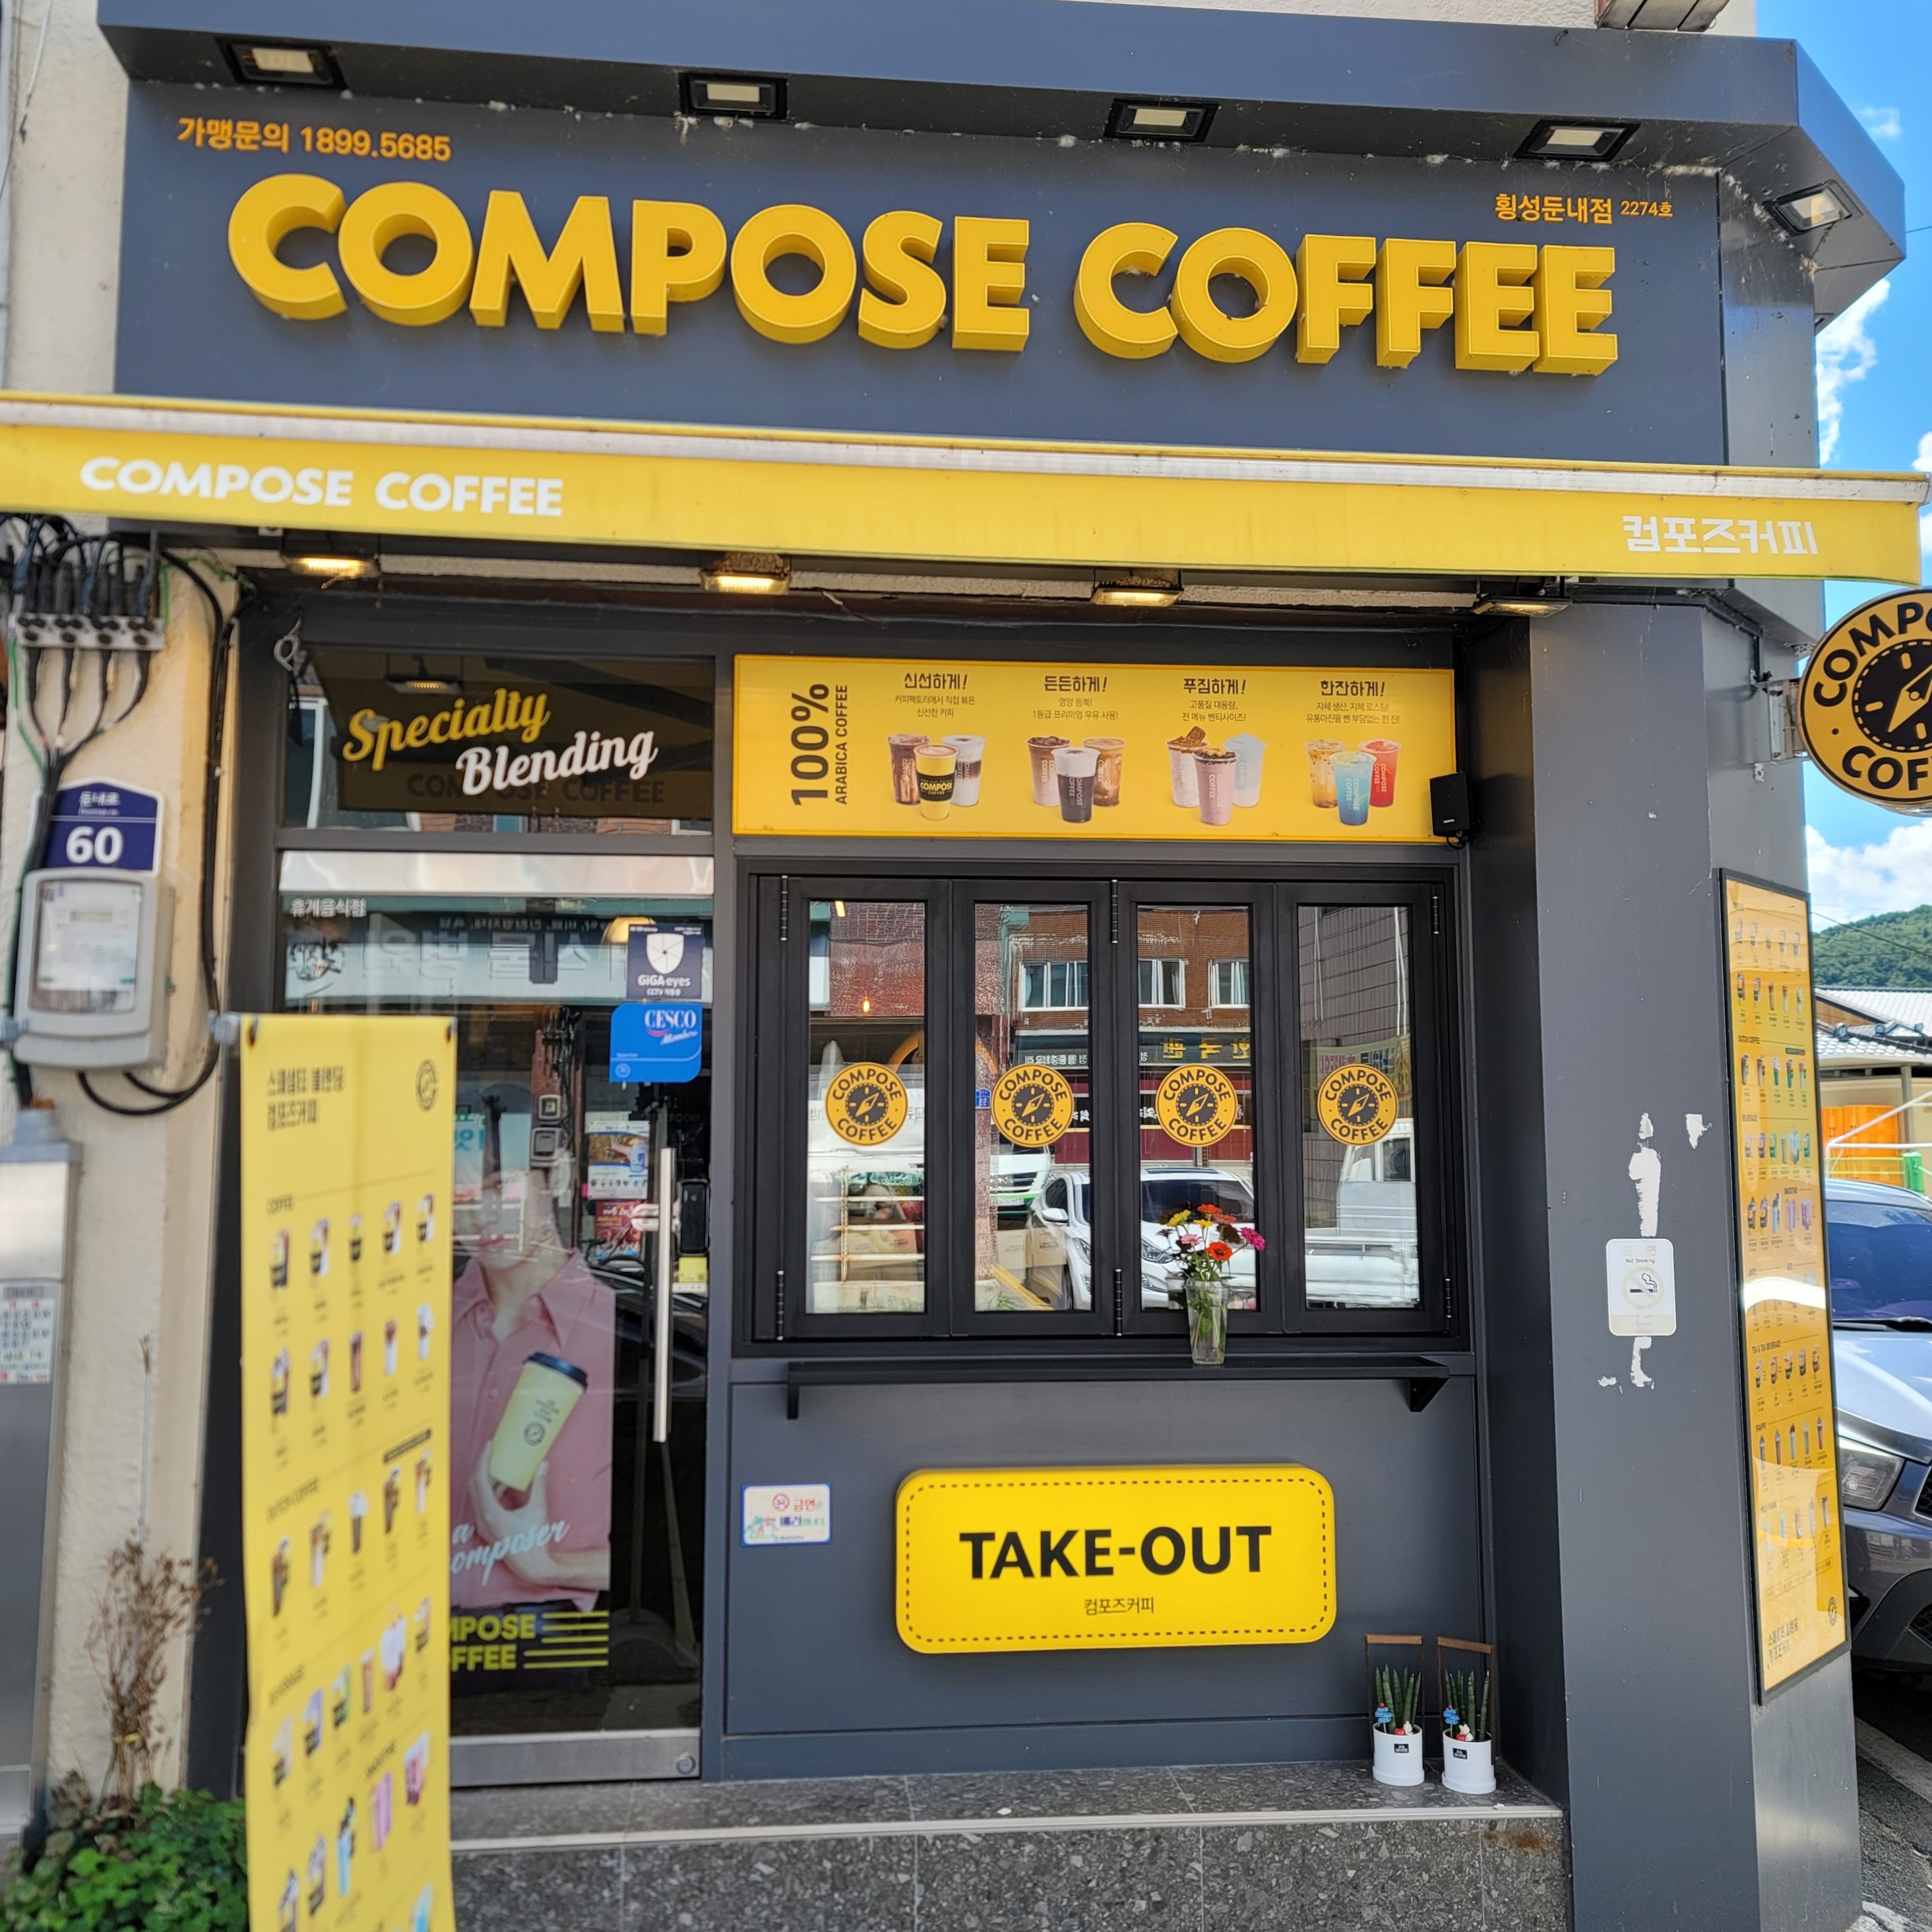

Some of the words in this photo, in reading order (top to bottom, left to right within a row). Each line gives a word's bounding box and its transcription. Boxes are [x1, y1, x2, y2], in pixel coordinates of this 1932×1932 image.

[177, 117, 289, 152] 가맹문의
[300, 127, 451, 162] 1899.5685
[1495, 193, 1612, 224] 횡성둔내점
[1619, 201, 1673, 218] 2274호
[228, 173, 1030, 352] COMPOSE
[1073, 222, 1618, 375] COFFEE
[79, 456, 354, 507] COMPOSE
[375, 471, 564, 516] COFFEE
[1623, 515, 1819, 555] 컴포즈커피
[1813, 602, 1932, 707] COMP
[904, 673, 968, 690] 신선하게!
[1044, 675, 1107, 692] 든든하게!
[1183, 678, 1246, 695] 푸짐하게!
[1321, 680, 1385, 697] 한잔하게!
[835, 685, 848, 737] COFFEE
[917, 708, 938, 718] 신선한
[940, 708, 954, 718] 커피
[945, 696, 959, 705] 직접
[1059, 698, 1073, 708] 영양
[1190, 701, 1212, 710] 고품질
[342, 687, 551, 770] Specialty
[1033, 710, 1051, 720] 1등급
[1053, 710, 1082, 720] 프리미엄
[1085, 711, 1100, 720] 우유
[1102, 711, 1119, 721] 사용!
[1182, 712, 1189, 722] 전
[1192, 713, 1206, 722] 메뉴
[1208, 713, 1246, 722] 벤티사이즈!
[1352, 714, 1380, 724] 부담없는
[791, 684, 829, 805] 100%
[455, 731, 658, 795] Blending
[835, 742, 848, 805] ARABICA
[1842, 745, 1932, 791] COF
[66, 826, 123, 864] 60
[290, 898, 367, 918] 휴게음식점
[644, 1009, 697, 1029] CESCO
[832, 1068, 902, 1101] COMPOSE
[999, 1069, 1067, 1101] COMPOSE
[1164, 1069, 1231, 1102] COMPOSE
[1324, 1069, 1392, 1102] COMPOSE
[837, 1117, 898, 1141] COFFEE
[1003, 1117, 1063, 1141] COFFEE
[1168, 1117, 1228, 1141] COFFEE
[1330, 1116, 1389, 1141] COFFEE
[449, 1519, 570, 1586] omposer
[959, 1526, 1272, 1580] TAKE-OUT
[1084, 1597, 1154, 1615] 컴포즈커피
[451, 1613, 536, 1642] POSE
[451, 1644, 517, 1672] FFEE
